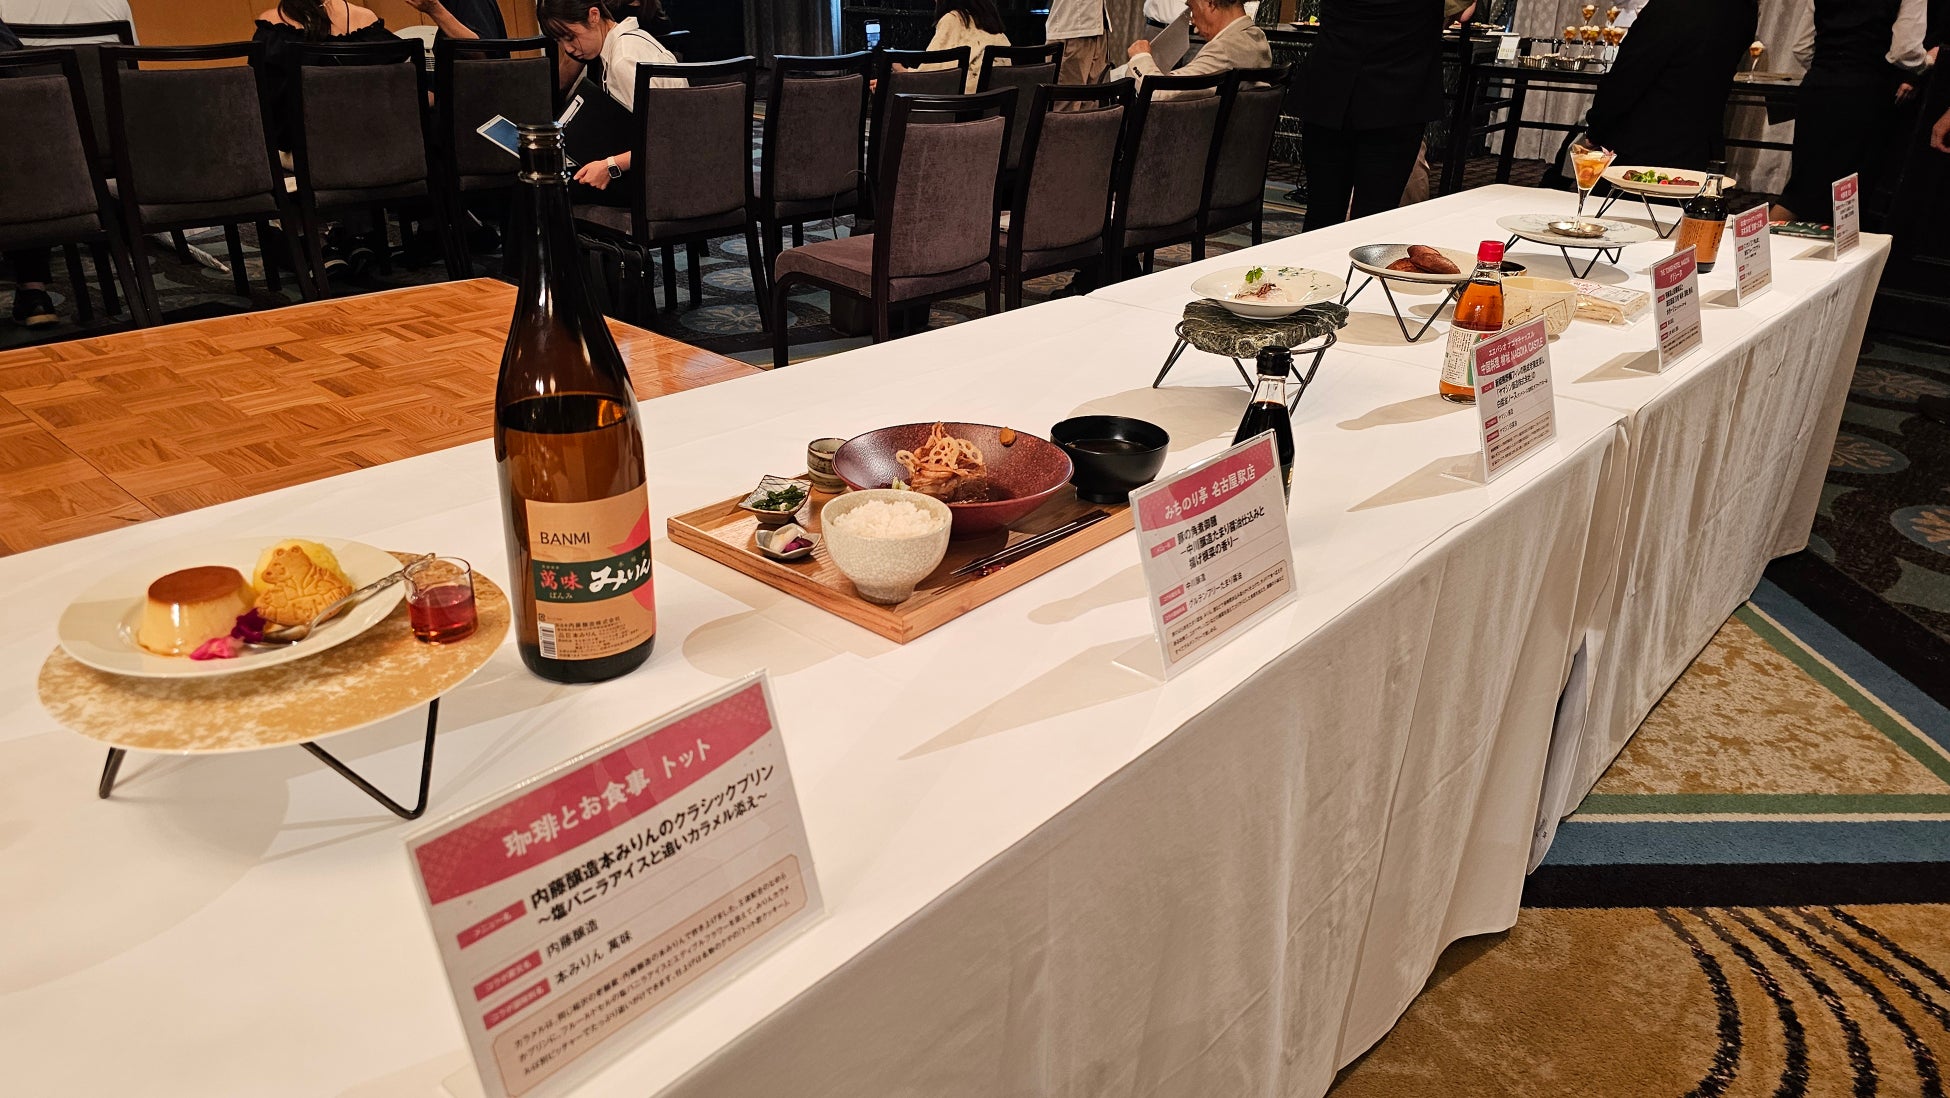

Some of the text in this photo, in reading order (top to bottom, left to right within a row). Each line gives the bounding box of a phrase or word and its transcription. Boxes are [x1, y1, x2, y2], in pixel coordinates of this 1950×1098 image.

[1165, 464, 1256, 520] みちのり亭 名古屋駅店
[540, 532, 590, 545] BANMI
[540, 559, 650, 592] 萬味 みりん
[501, 734, 713, 862] 珈琲とお食事 トット
[528, 761, 776, 911] 内藤醸造本みりんのクラシックプリン
[544, 916, 599, 959] 内藤醸造
[553, 927, 634, 986] 本みりん 萬味
